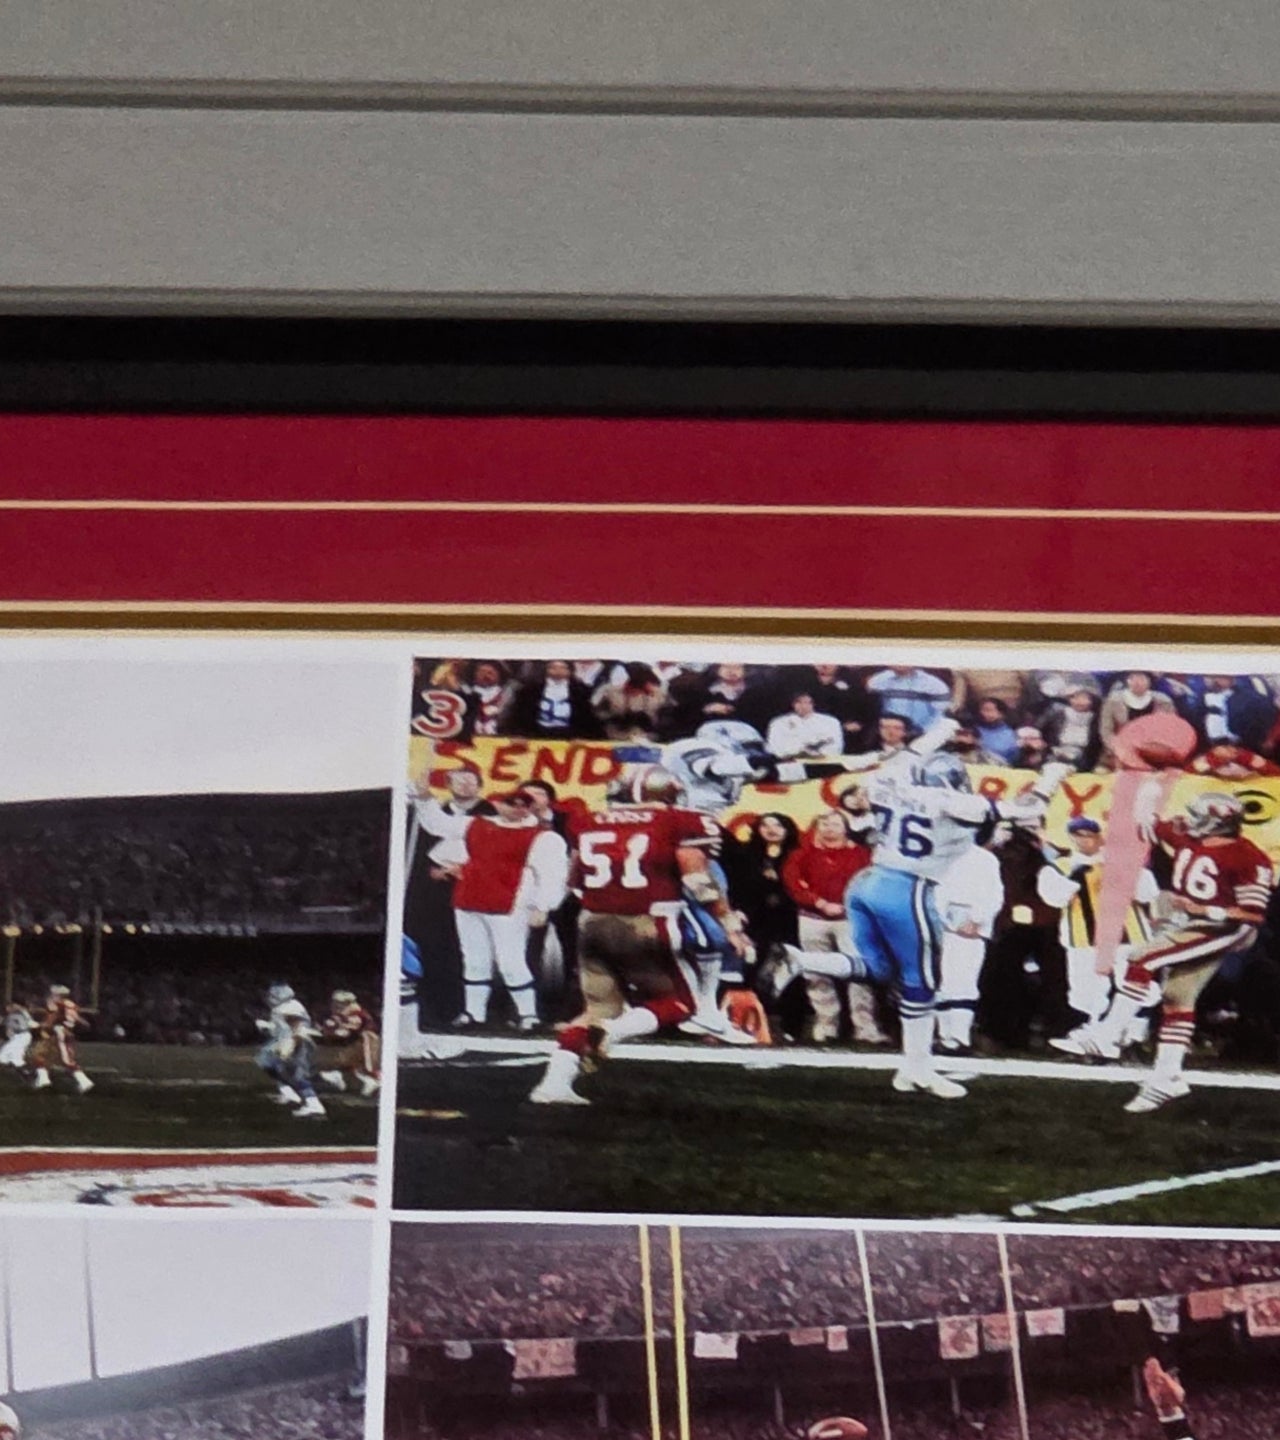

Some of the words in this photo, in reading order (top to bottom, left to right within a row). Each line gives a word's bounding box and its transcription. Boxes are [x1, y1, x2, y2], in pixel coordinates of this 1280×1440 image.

[411, 689, 467, 738] 3
[578, 820, 651, 889] 51
[870, 802, 935, 859] 76
[1172, 847, 1219, 901] 16
